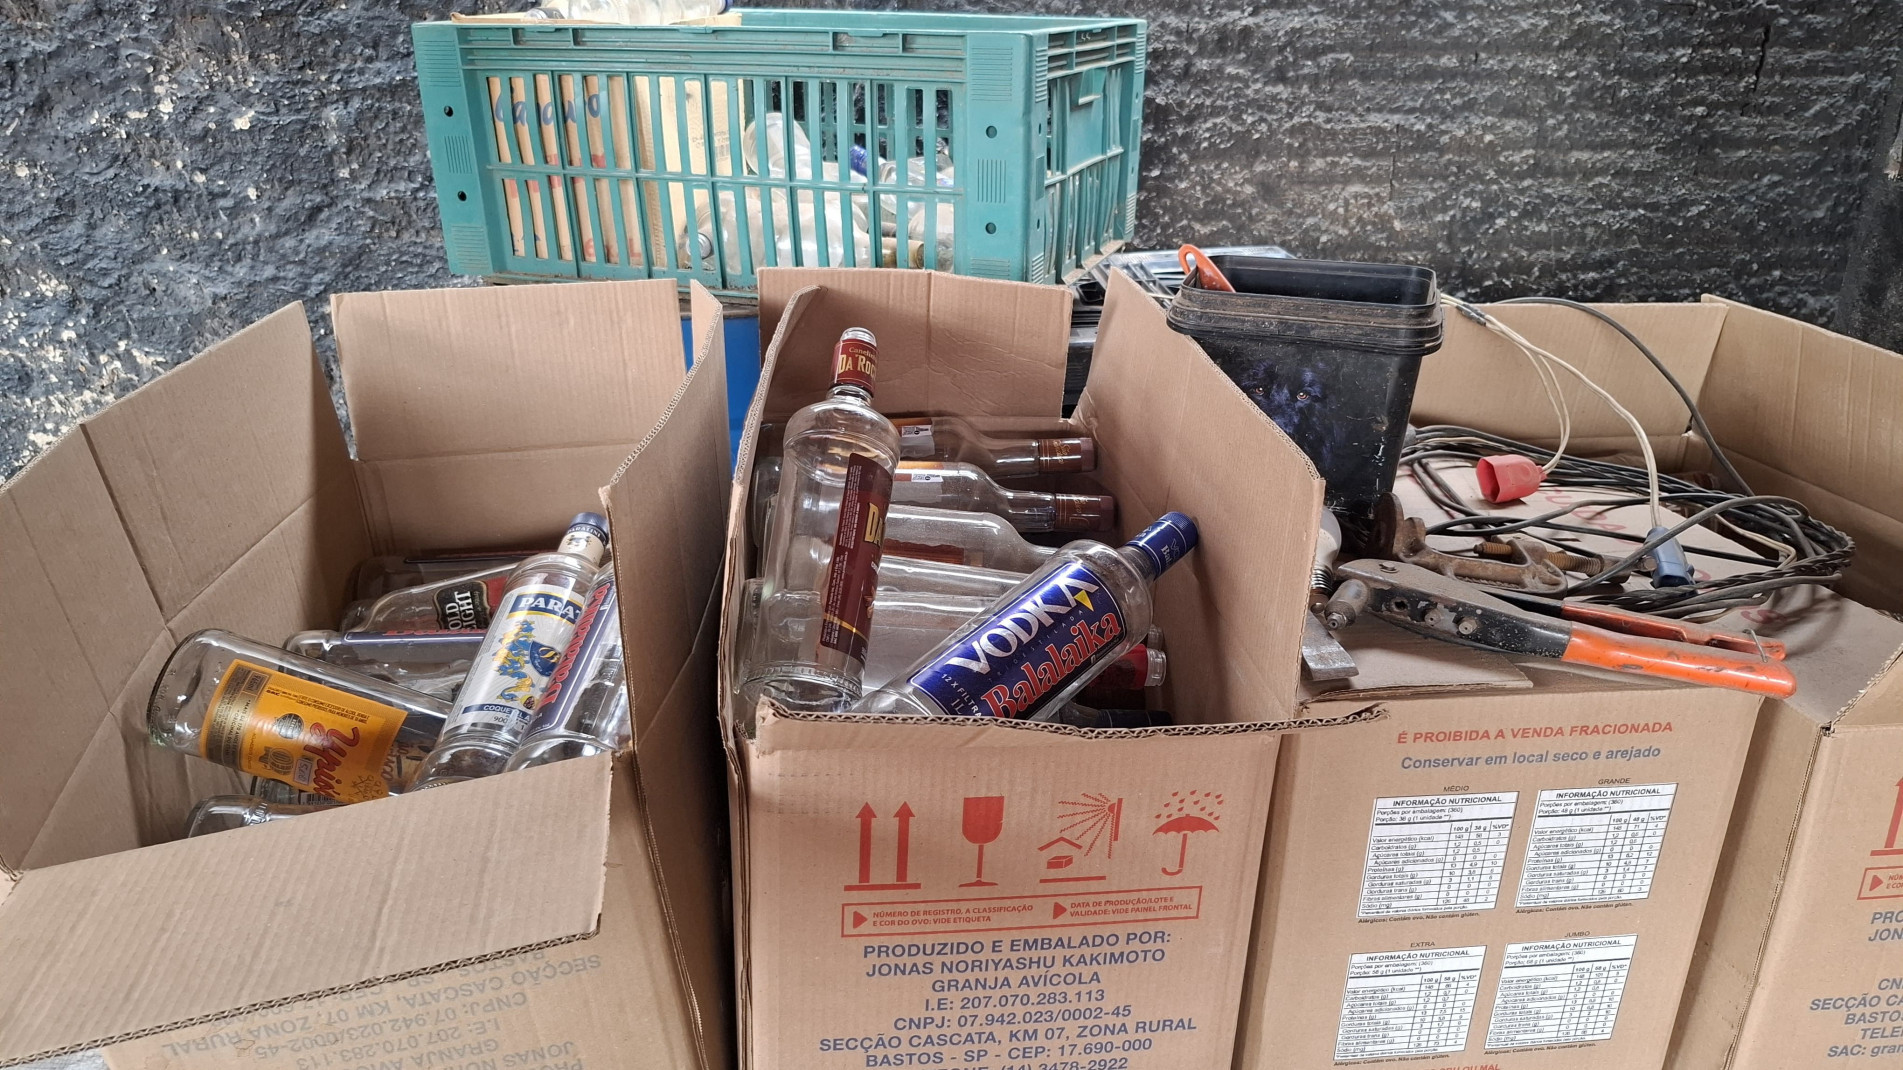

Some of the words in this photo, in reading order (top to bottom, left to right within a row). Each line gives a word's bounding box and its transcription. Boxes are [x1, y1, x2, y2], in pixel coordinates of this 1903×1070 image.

[445, 602, 462, 630] OLD
[944, 577, 1100, 676] VODKA
[980, 612, 1121, 719] Balalaika
[941, 673, 952, 684] 12
[1397, 730, 1408, 744] É
[1413, 729, 1491, 744] PROIBIDA
[1494, 728, 1506, 740] A
[1510, 726, 1565, 739] VENDA
[1569, 721, 1673, 737] FRACIONADA
[1401, 756, 1482, 769] Conservar
[1485, 754, 1508, 765] em
[1512, 750, 1549, 764] local
[1552, 751, 1589, 762] seco
[1592, 750, 1602, 760] e
[1605, 745, 1661, 762] arejado
[1598, 777, 1631, 785] GRANDE
[1392, 798, 1447, 807] INFORMAÇÃO
[1448, 795, 1502, 805] NUTRICIONAL
[1555, 790, 1609, 800] INFORMAÇÃO
[1609, 788, 1661, 797] NUTRICIONAL
[873, 910, 908, 919] NÚMERO
[923, 908, 963, 917] REGISTRO,
[972, 904, 1034, 915] CLASSIFICAÇÃO
[1070, 908, 1111, 918] VALIDADE:
[1111, 907, 1129, 915] VIDE
[1130, 905, 1157, 914] PAINEL
[1158, 903, 1193, 912] FRONTAL
[1092, 900, 1103, 908] DE
[879, 919, 896, 927] COR
[911, 918, 932, 926] OVO:
[932, 917, 952, 925] VIDE
[953, 915, 991, 924] ETIQUETA
[863, 940, 985, 959] PRODUZIDO
[991, 939, 1004, 954] E
[1010, 933, 1120, 952] EMBALADO
[1125, 930, 1172, 946] POR:
[1366, 952, 1418, 962] INFORMAÇÃO
[1419, 950, 1470, 959] NUTRICIONAL
[1521, 942, 1572, 952] INFORMAÇÃO
[1572, 939, 1622, 948] NUTRICIONAL
[511, 954, 601, 987] SECÇÃO
[865, 961, 934, 978] JONAS
[940, 955, 1055, 975] NORIYASHU
[1062, 949, 1166, 968] KAKIMOTO
[396, 976, 504, 1009] CASCATA,
[931, 976, 1012, 993] GRANJA
[1018, 970, 1101, 989] AVÍCOLA
[357, 1000, 392, 1020] KM
[464, 991, 527, 1015] CNPJ:
[925, 998, 954, 1012] I.E:
[959, 988, 1105, 1010] 207.070.283.113
[1809, 992, 1881, 1012] SECÇÃO
[248, 1016, 313, 1040] ZONA
[317, 1009, 349, 1027] 07,
[468, 1018, 501, 1035] I.E:
[893, 1016, 951, 1031] CNPJ:
[957, 1005, 1132, 1028] 07.942.023/0002-45
[162, 1032, 243, 1057] RURAL
[254, 1008, 457, 1060] 07.942.023/0002-45
[819, 1033, 902, 1053] SECÇÃO
[908, 1031, 1002, 1048] CASCATA,
[1008, 1029, 1039, 1043] KM
[1044, 1027, 1070, 1041] 07,
[1076, 1022, 1129, 1039] ZONA
[1135, 1017, 1197, 1034] RURAL
[410, 1038, 500, 1067] GRANJA
[502, 1041, 574, 1069] JONAS
[865, 1051, 944, 1068] BASTOS
[963, 1050, 989, 1063] SP
[1007, 1046, 1051, 1060] CEP:
[1058, 1038, 1153, 1057] 17.690-000
[1827, 1044, 1867, 1057] SAC:
